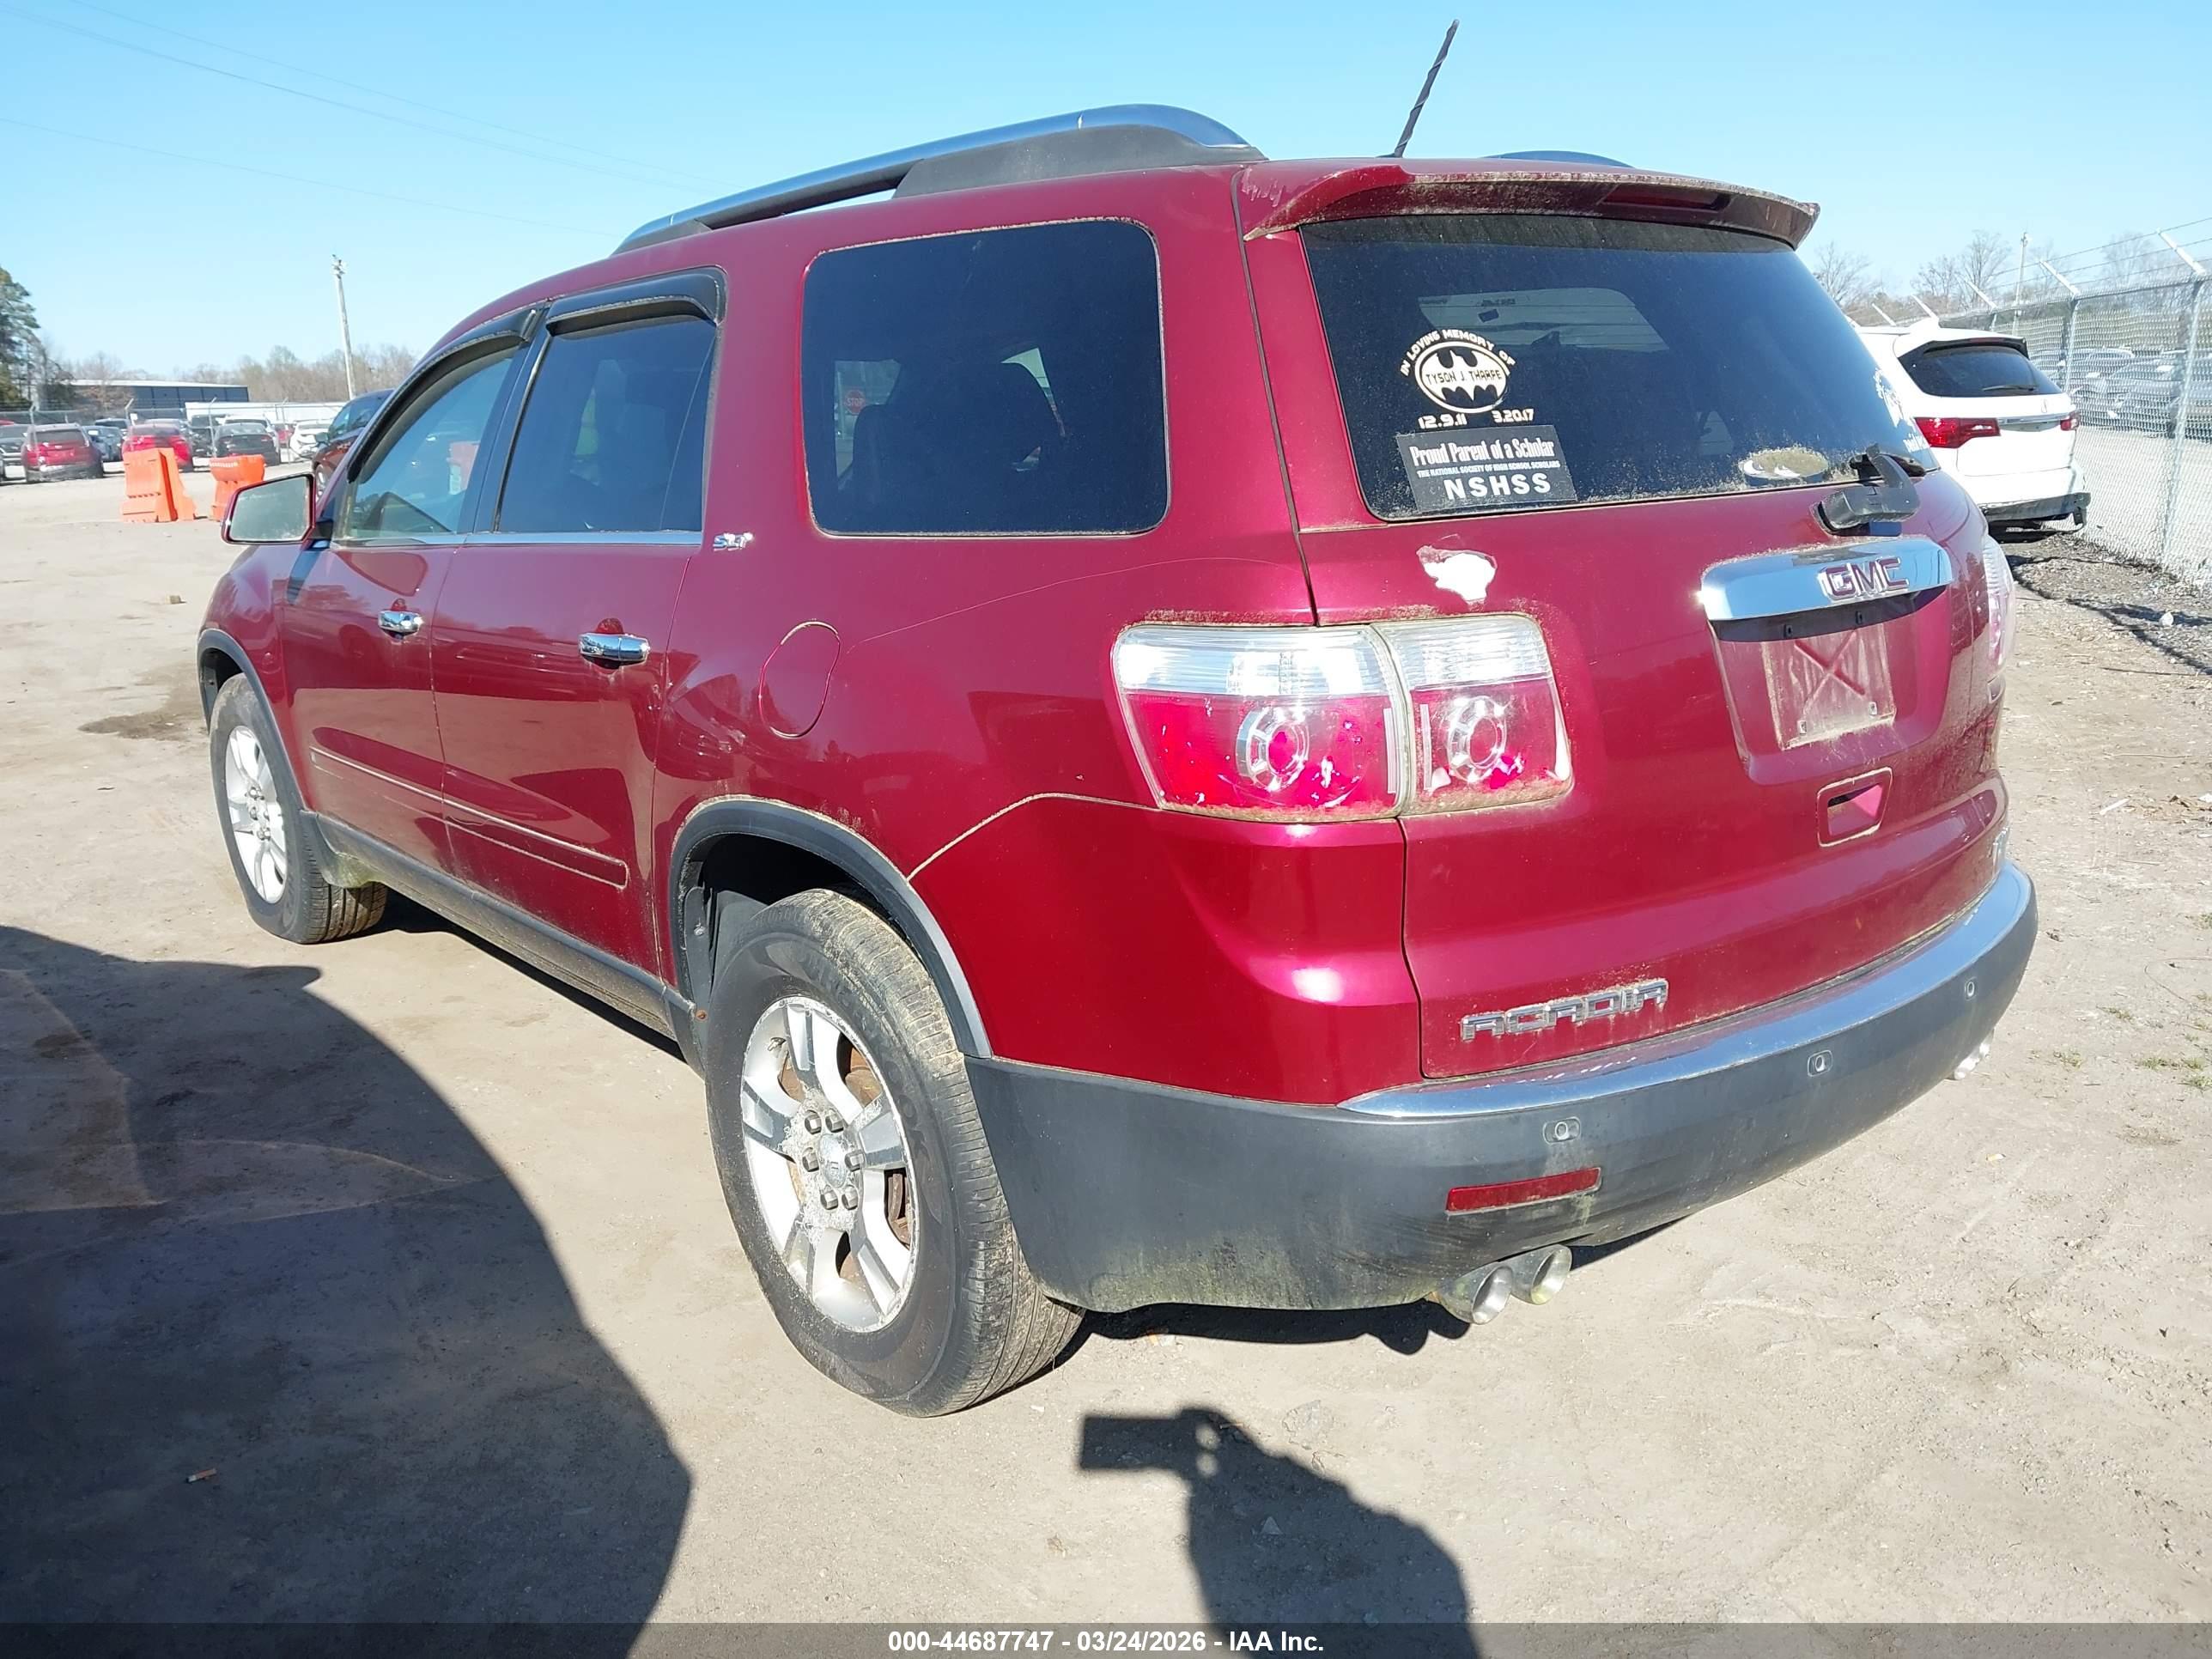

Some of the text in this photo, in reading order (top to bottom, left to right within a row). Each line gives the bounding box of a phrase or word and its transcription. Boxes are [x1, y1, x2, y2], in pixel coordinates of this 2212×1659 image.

[1400, 329, 1516, 376] IN LOVING MEMORY OF
[1425, 372, 1457, 386] TYSON
[846, 397, 865, 406] STOP
[1418, 413, 1468, 429] 12.9.11
[1409, 437, 1555, 466] Proud Parent of a Scholar
[1417, 469, 1431, 478] THE
[1431, 466, 1460, 476] NATIONAL
[1460, 465, 1485, 473] SOCIETY
[1509, 461, 1531, 471] SCHOOL
[1531, 460, 1561, 469] SCHOLARS
[1443, 472, 1551, 501] NSHSS
[1817, 556, 1910, 603] GMC
[1460, 978, 1669, 1042] ACADIA
